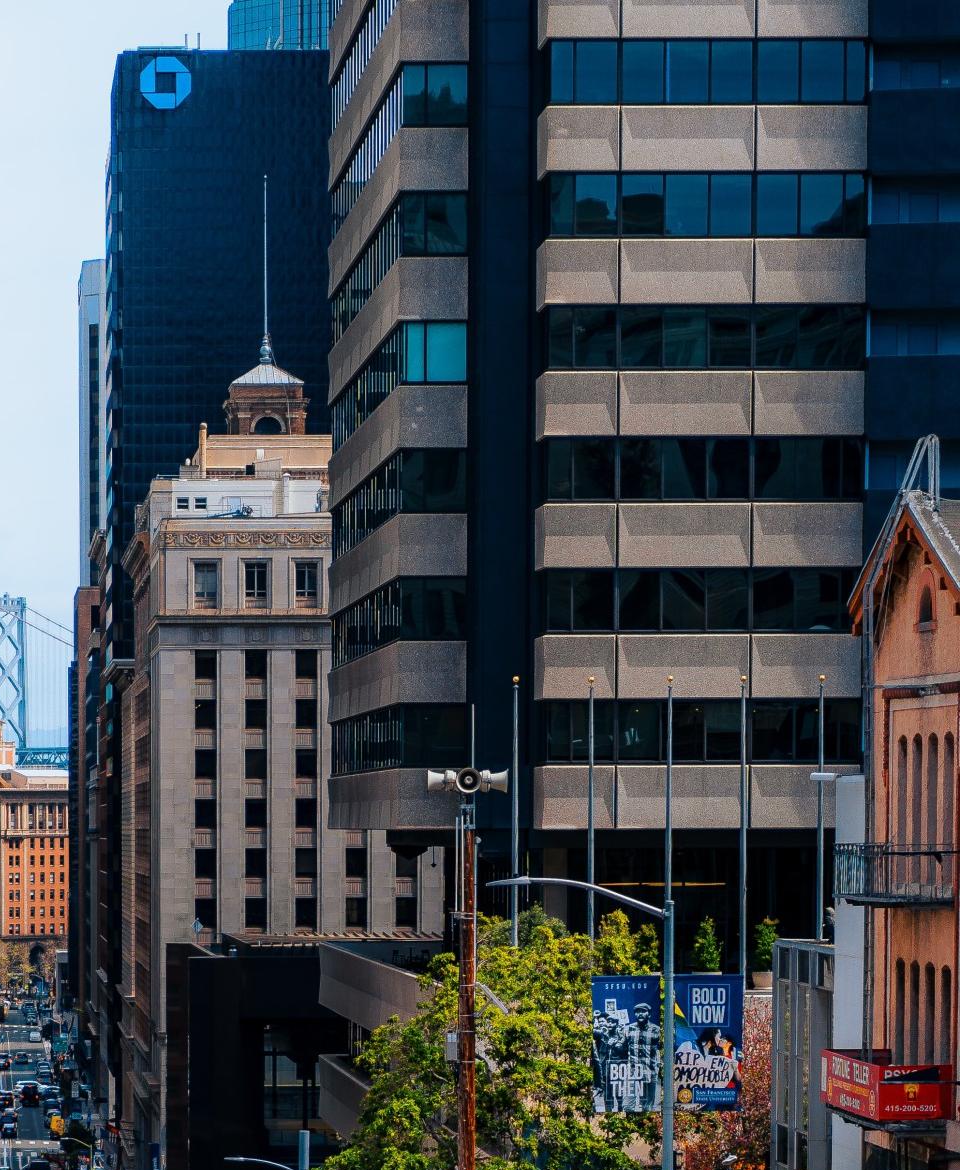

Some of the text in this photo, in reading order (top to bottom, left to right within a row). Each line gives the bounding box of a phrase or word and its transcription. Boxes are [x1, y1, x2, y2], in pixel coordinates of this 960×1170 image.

[692, 988, 726, 1004] BOLD
[692, 1006, 725, 1023] NOW
[610, 1063, 643, 1080] BOLD
[710, 1057, 730, 1071] END
[610, 1081, 644, 1097] THEN
